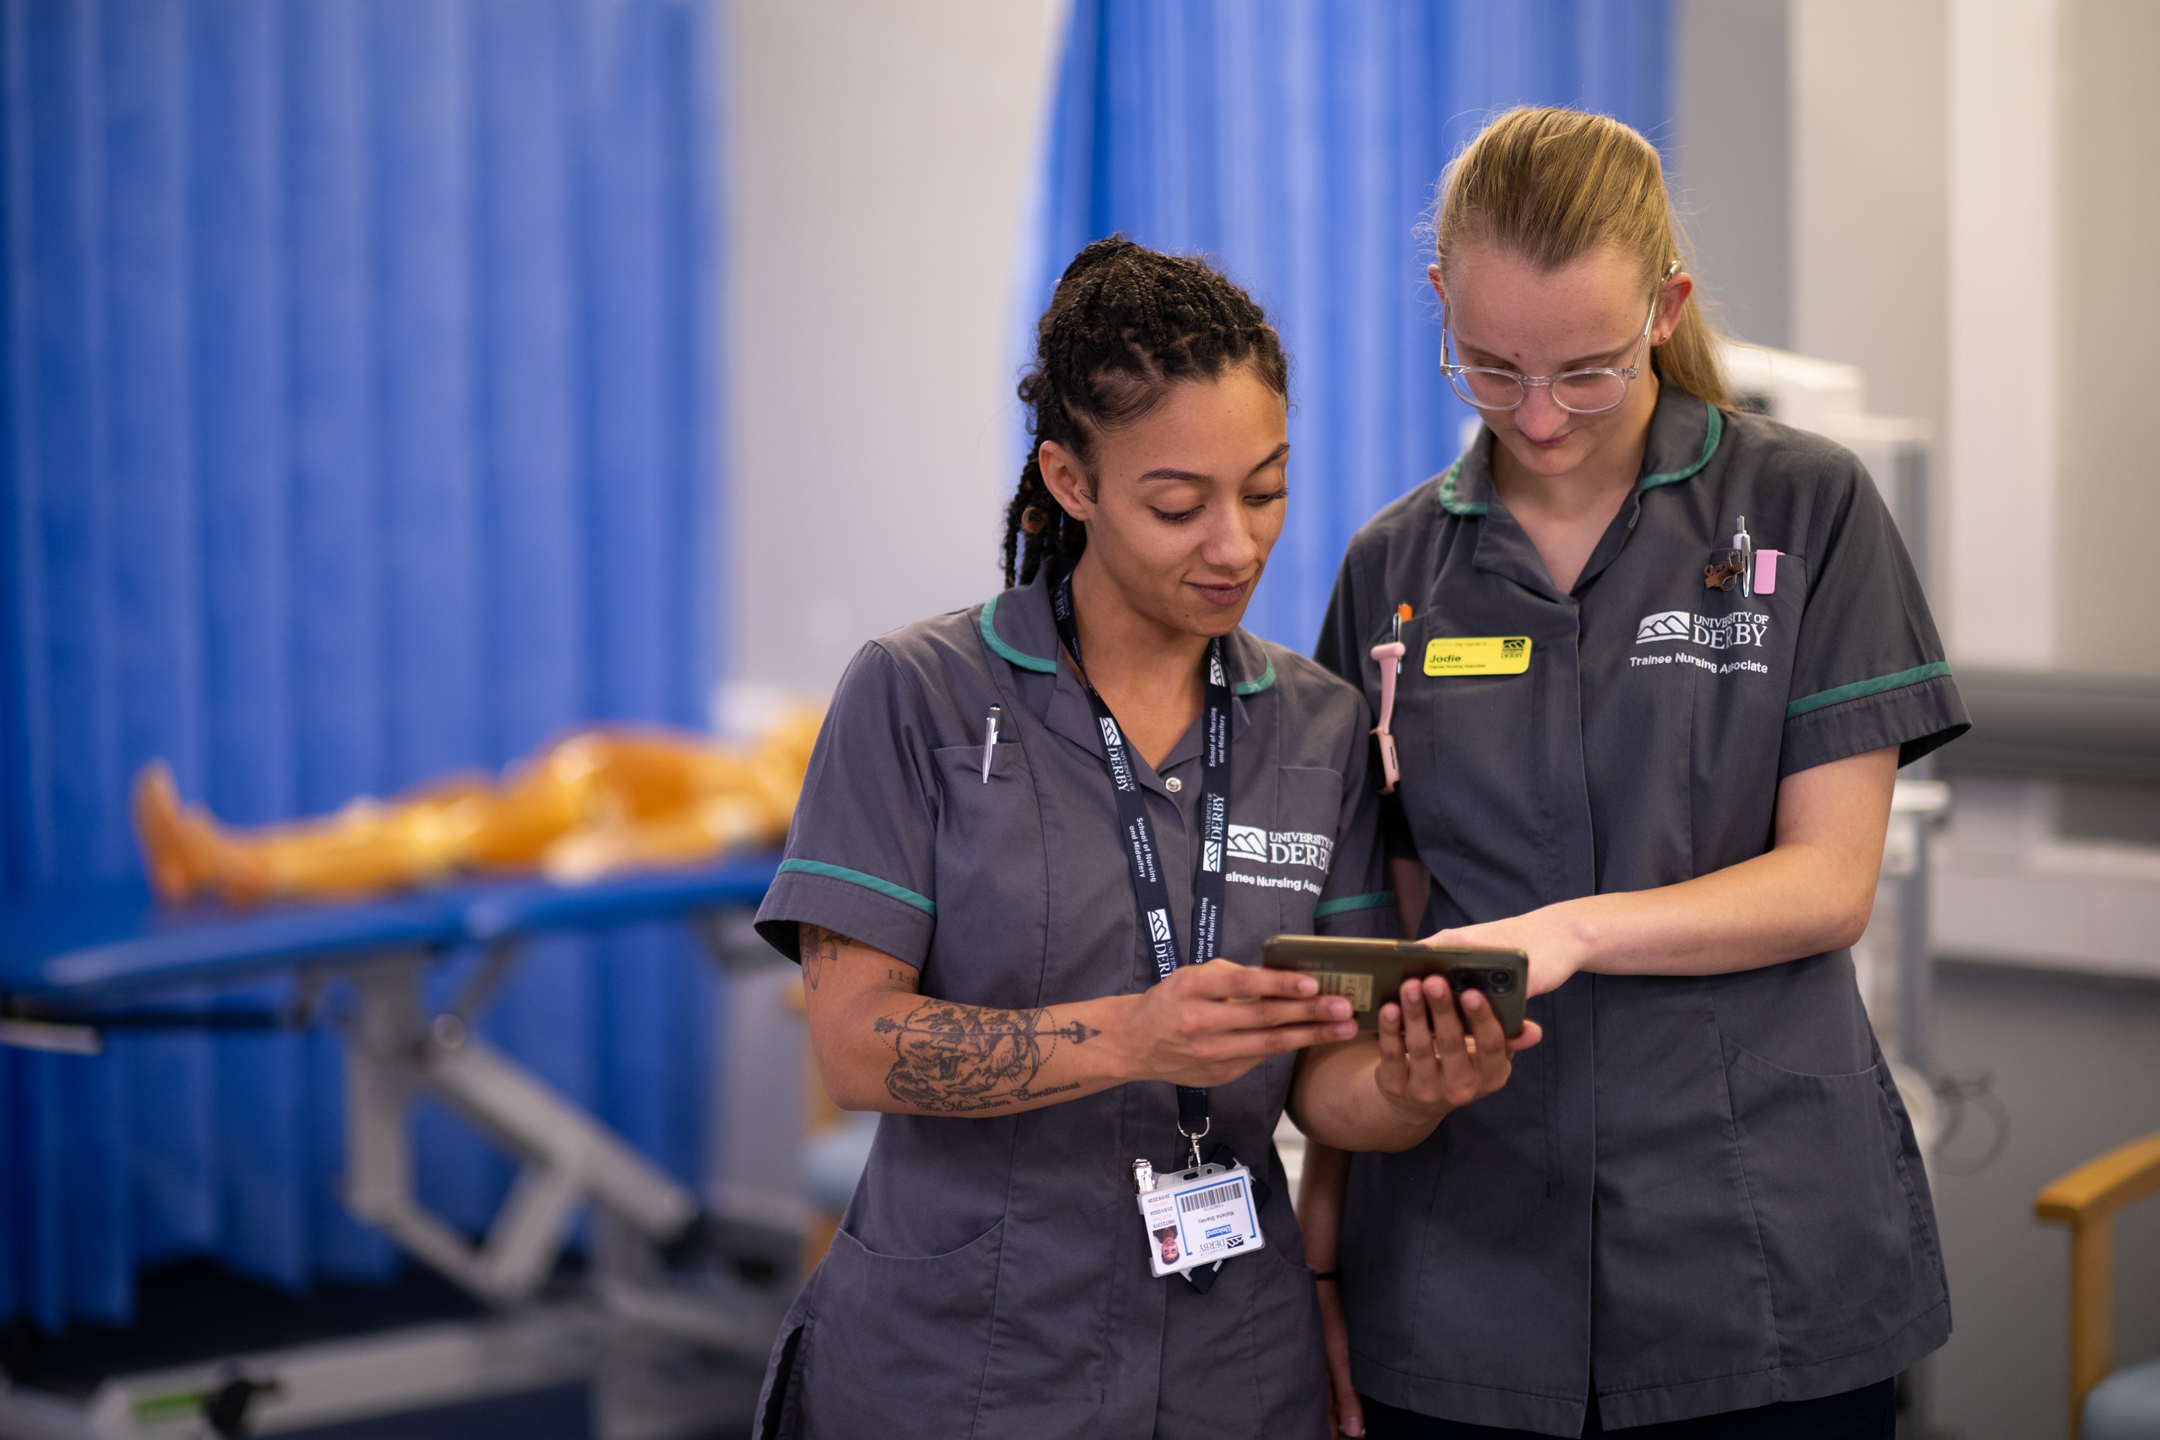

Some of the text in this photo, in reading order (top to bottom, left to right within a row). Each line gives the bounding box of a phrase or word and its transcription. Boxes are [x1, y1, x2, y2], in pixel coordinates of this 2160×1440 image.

[1693, 611, 1769, 629] UNIVERSITY OF
[1692, 623, 1768, 650] DERBY
[1429, 654, 1462, 663] Jodie
[1629, 652, 1769, 675] Trainee Nursing Associate
[1209, 707, 1218, 734] Nursing
[1218, 714, 1226, 749] Midwifery
[1209, 734, 1216, 743] of
[1107, 747, 1131, 792] DERBY
[1118, 746, 1136, 792] UNIVERSITY OF
[1211, 793, 1225, 841] DERBY
[1129, 825, 1146, 878] and Midwifery
[1136, 817, 1157, 883] School of Nursing
[1269, 831, 1330, 849] UNIVERSITY
[1269, 843, 1331, 875] DERBY
[1225, 871, 1255, 885] ainee
[1256, 875, 1302, 891] Nursing
[1195, 897, 1209, 964] School of Nursing
[1207, 904, 1217, 941] Midwifery
[1154, 942, 1171, 982] DER
[914, 1082, 1081, 1112] The Marathon Continues
[1199, 1239, 1226, 1252] DERBY
[1206, 1225, 1231, 1238] Unicard
